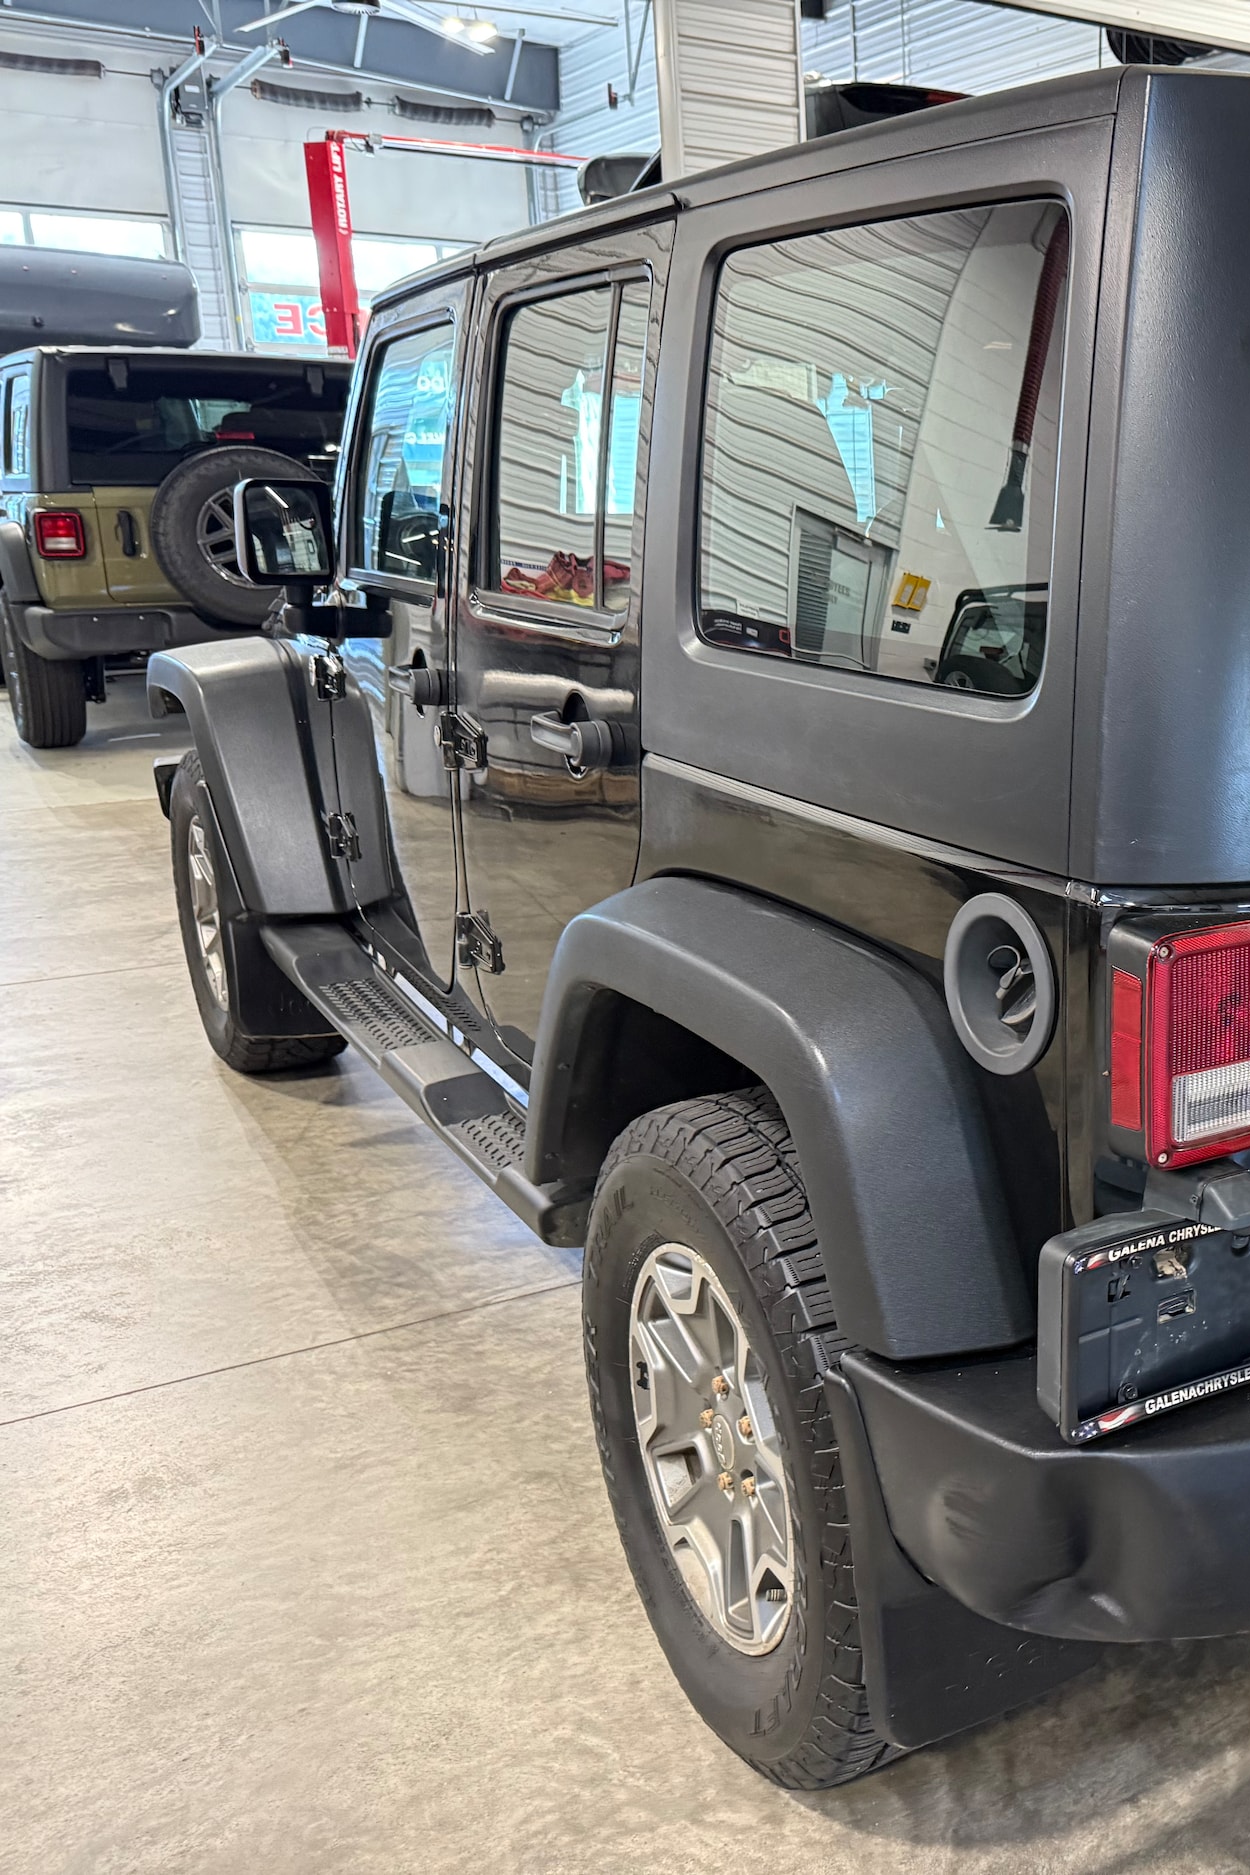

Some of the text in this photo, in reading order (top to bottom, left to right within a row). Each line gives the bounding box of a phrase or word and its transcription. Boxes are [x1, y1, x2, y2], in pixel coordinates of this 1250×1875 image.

[332, 175, 349, 229] ROTARY
[1108, 1234, 1165, 1262] GALENA
[1168, 1223, 1222, 1244] CHRYSL
